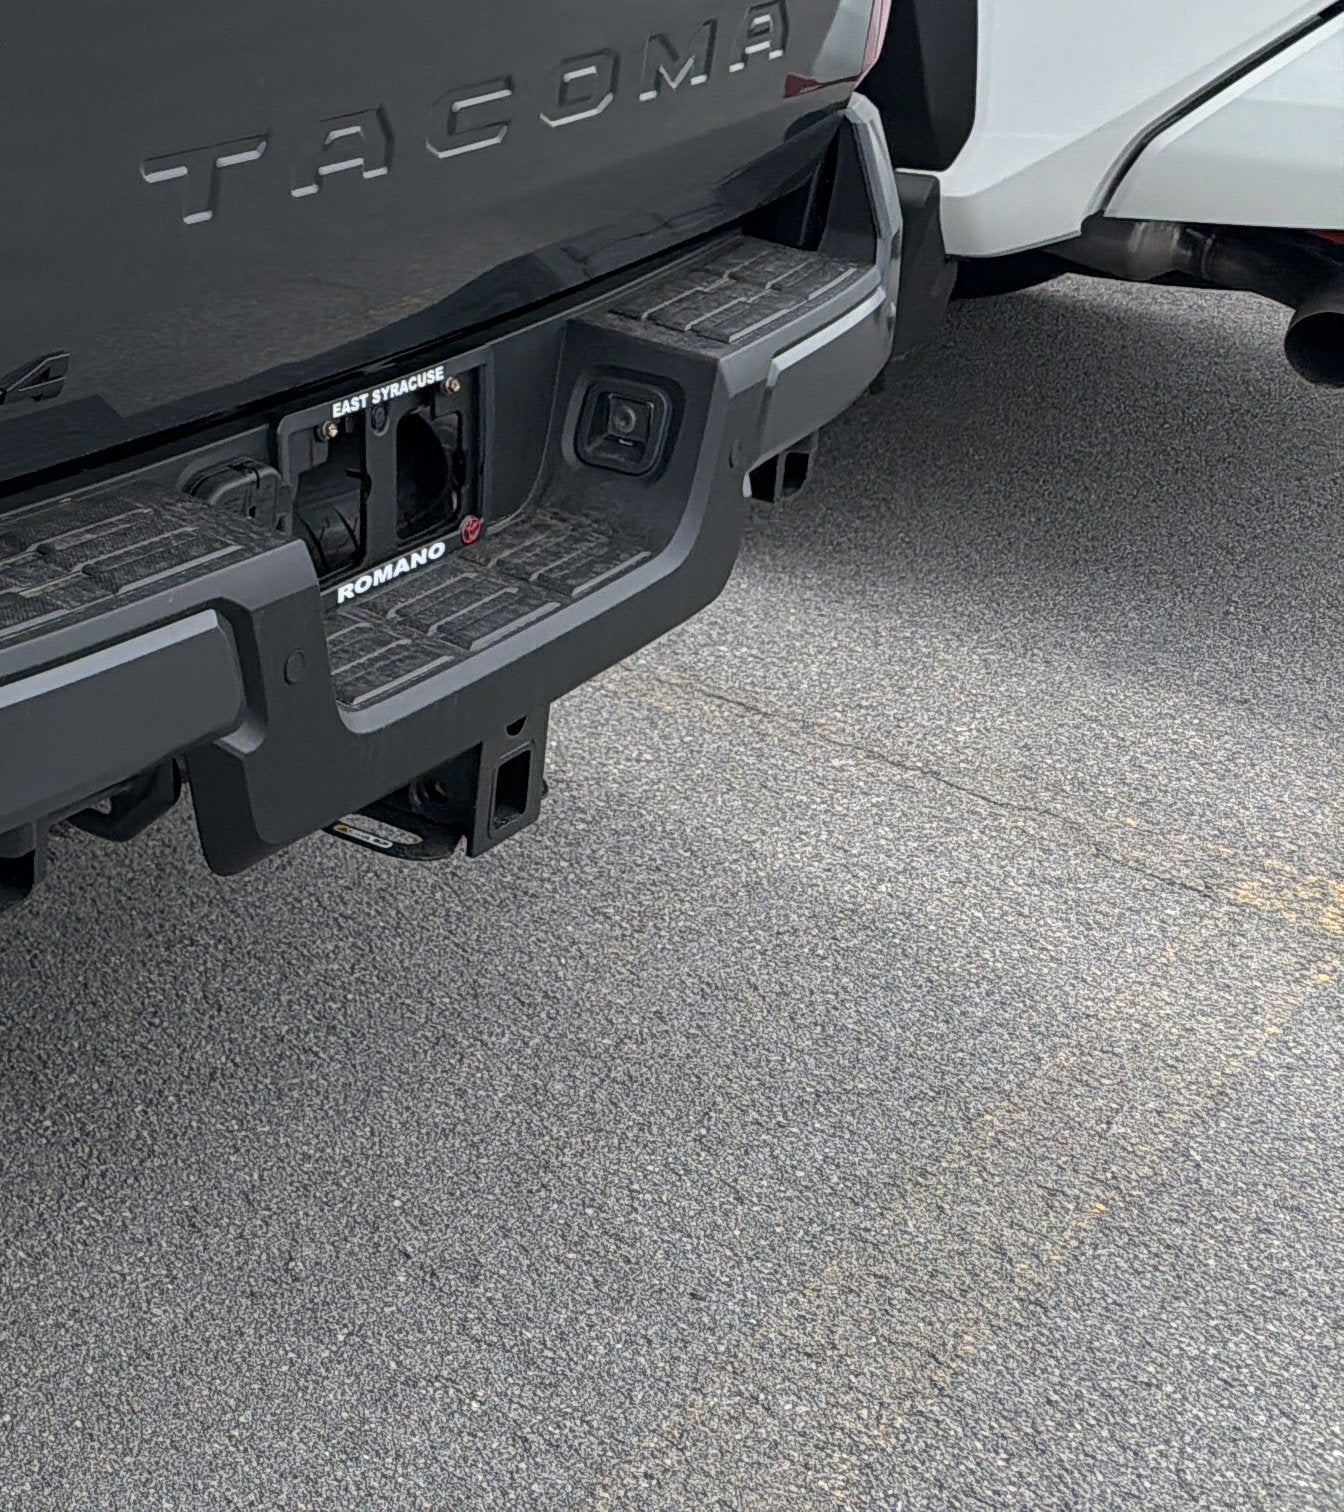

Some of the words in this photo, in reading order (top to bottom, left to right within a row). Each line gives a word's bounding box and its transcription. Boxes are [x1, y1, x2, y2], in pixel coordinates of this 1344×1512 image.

[331, 393, 369, 419] EAST
[371, 365, 446, 405] SYRACUSE
[337, 541, 446, 604] ROMANO
